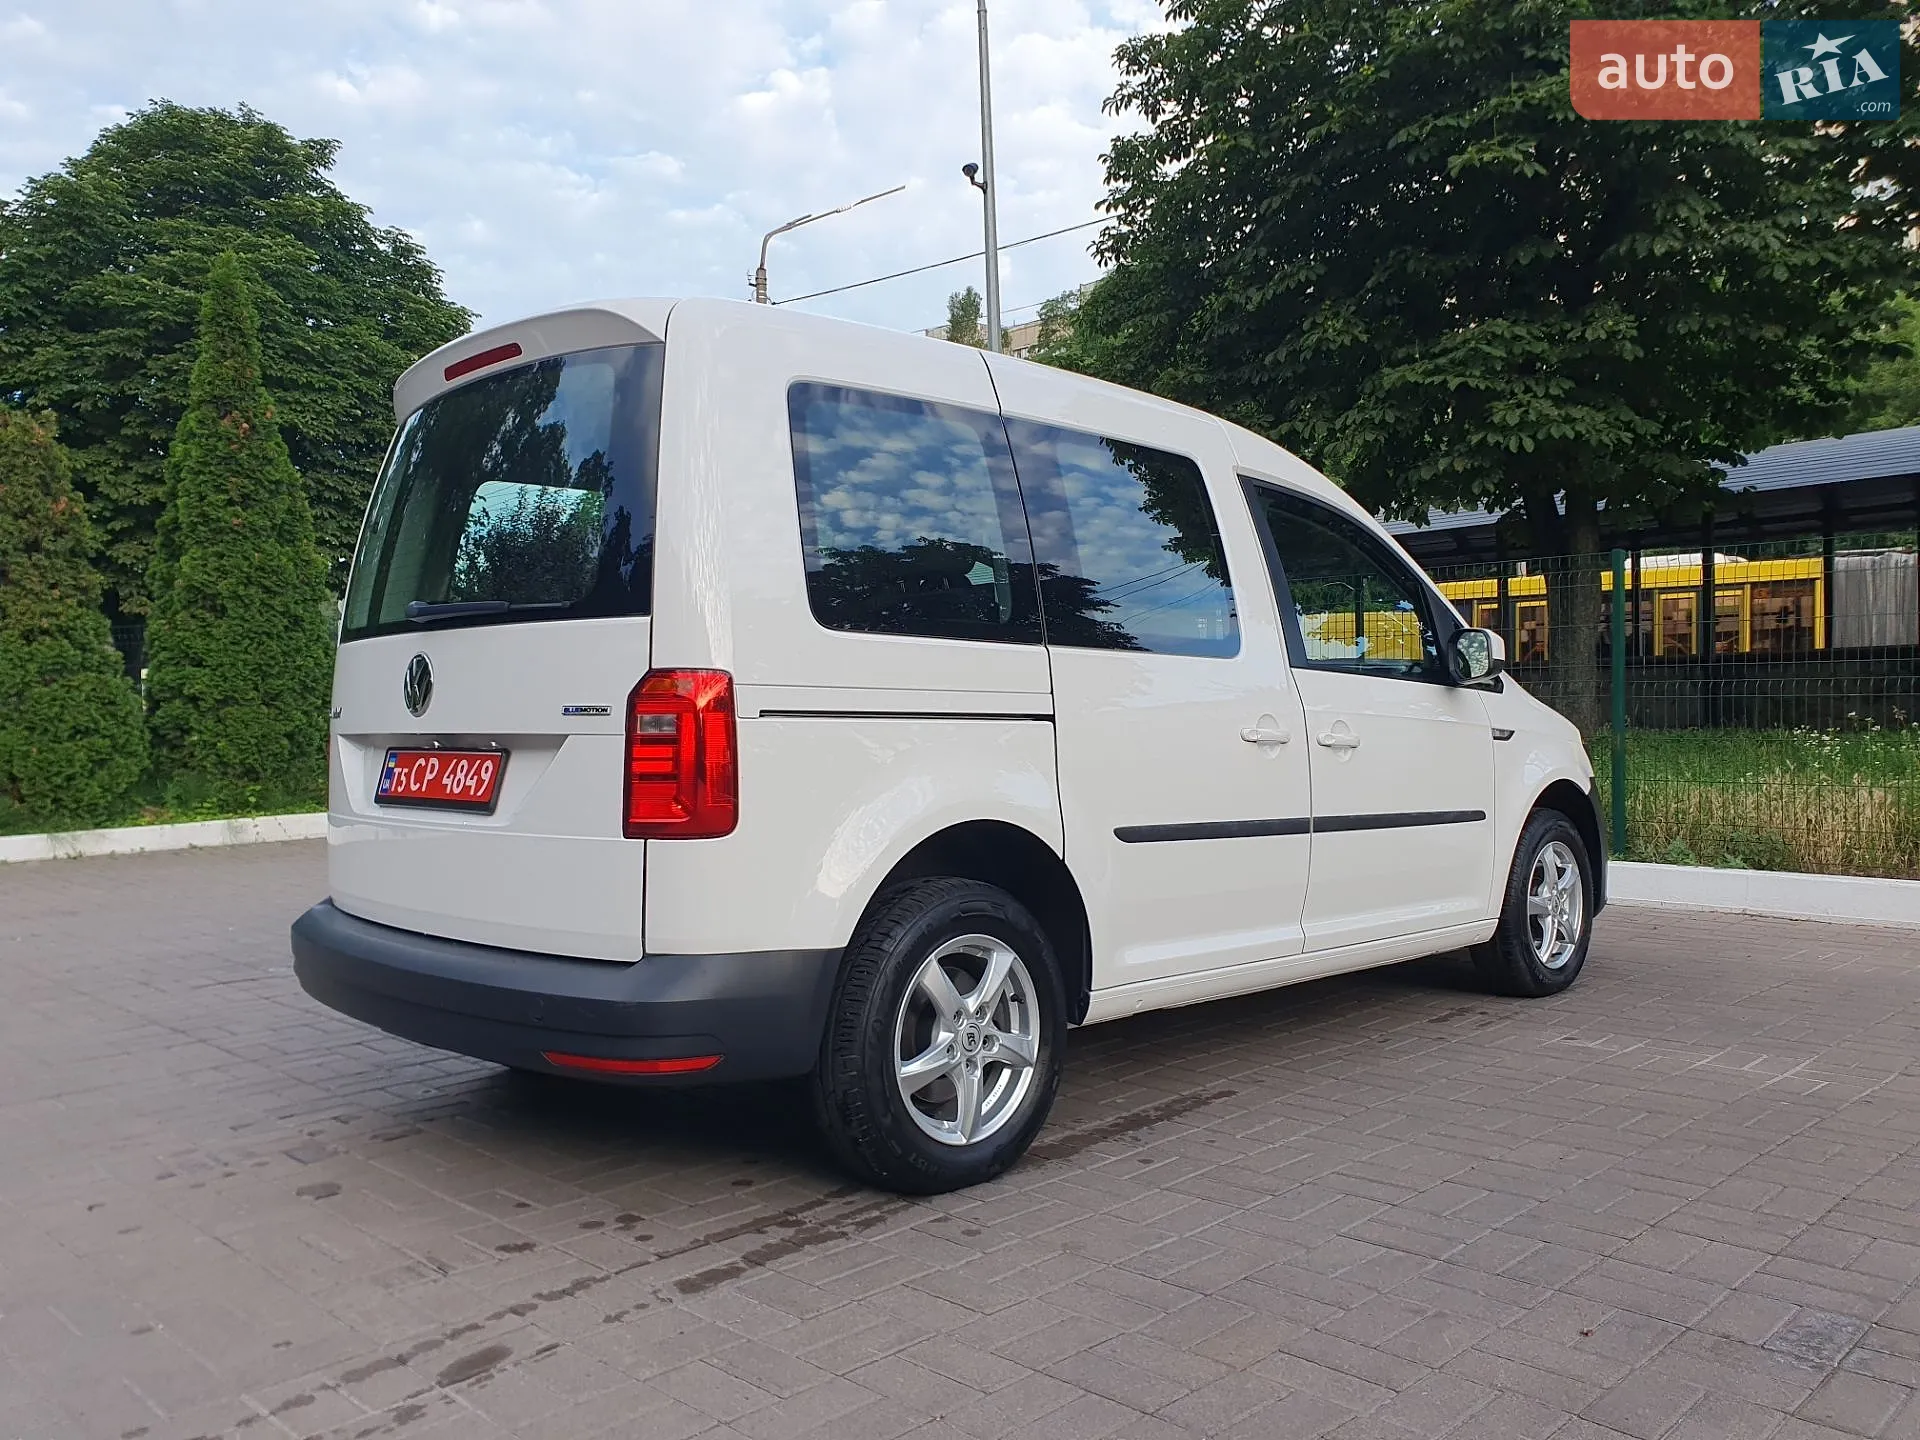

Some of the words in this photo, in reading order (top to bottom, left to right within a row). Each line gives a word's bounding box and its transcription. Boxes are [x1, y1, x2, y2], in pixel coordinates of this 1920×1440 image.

[563, 706, 609, 714] BLUEMOTION
[390, 767, 409, 793] T5
[409, 757, 440, 793] CP
[441, 758, 494, 797] 4849
